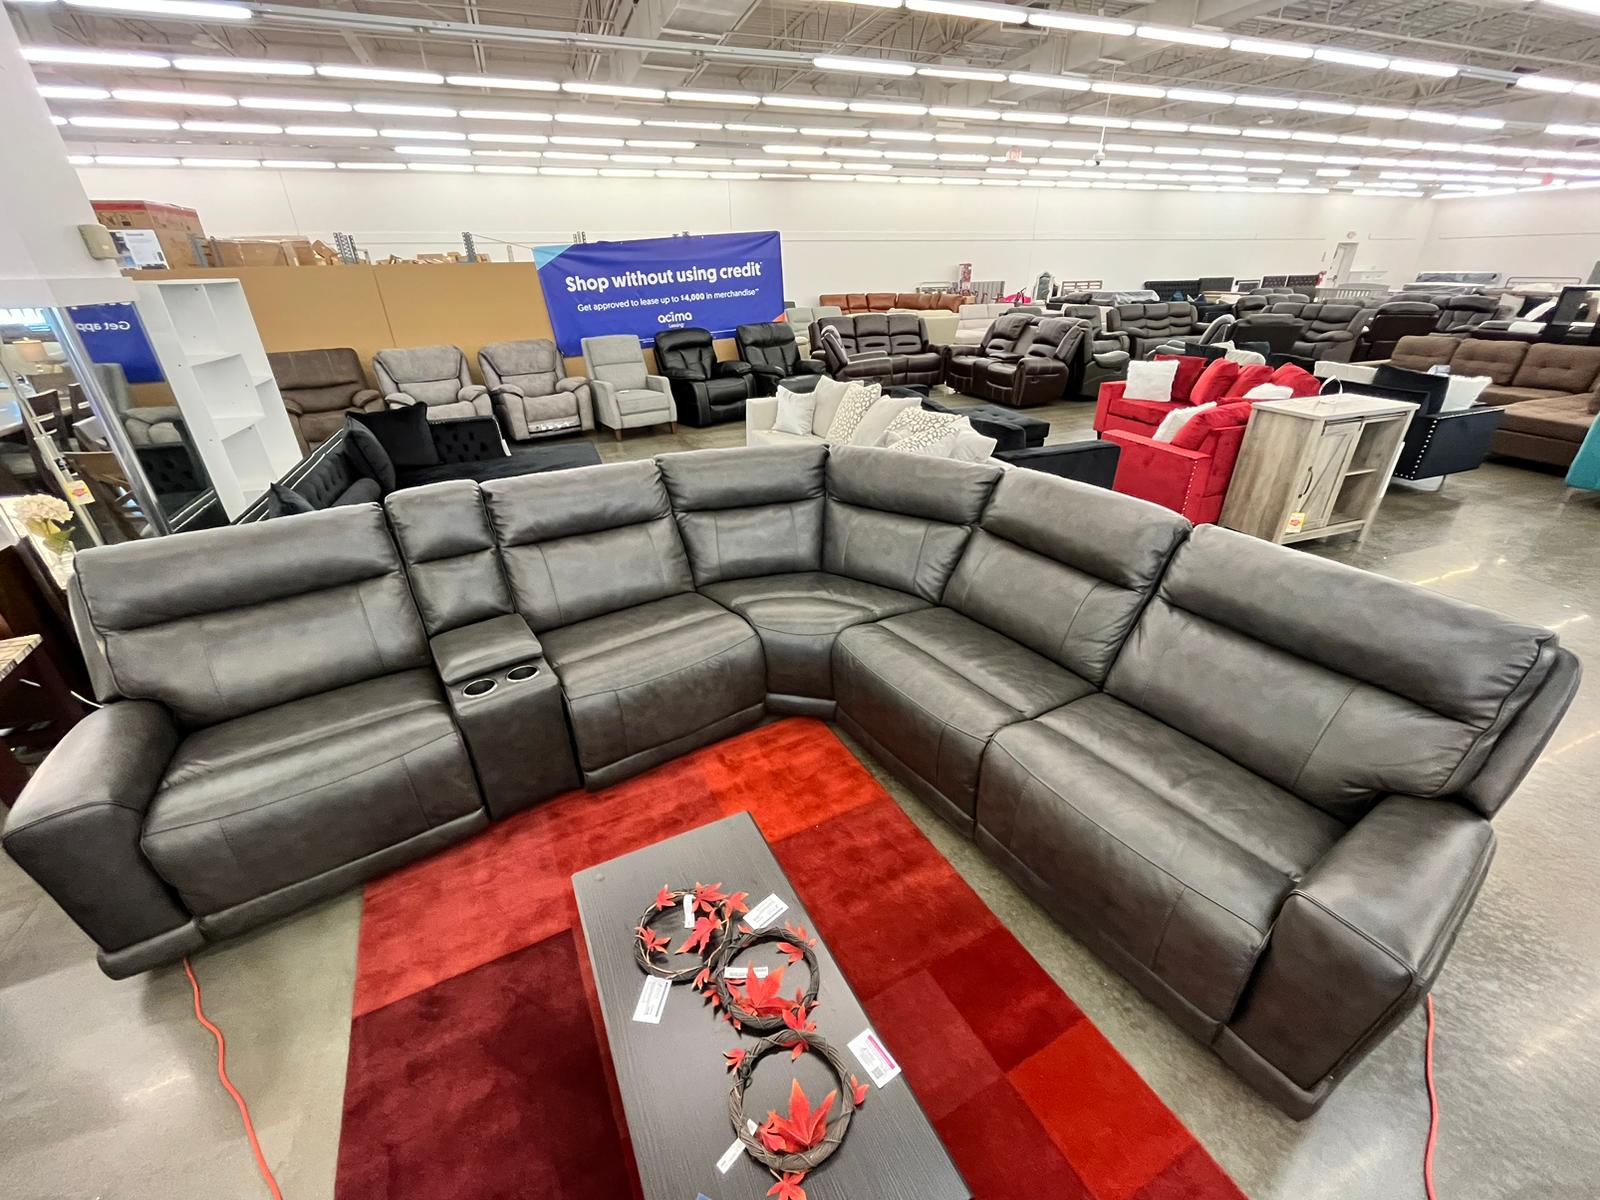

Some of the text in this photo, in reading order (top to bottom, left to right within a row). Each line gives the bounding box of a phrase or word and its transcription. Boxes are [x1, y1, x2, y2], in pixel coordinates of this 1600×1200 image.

[565, 276, 610, 293] Shop
[611, 270, 674, 288] without
[676, 266, 717, 283] using
[577, 303, 592, 312] Get
[593, 299, 630, 312] approved
[631, 299, 639, 307] to
[640, 297, 660, 306] lease
[660, 296, 670, 305] up
[680, 292, 705, 303] $4,000
[706, 292, 713, 300] in
[657, 311, 693, 323] acima
